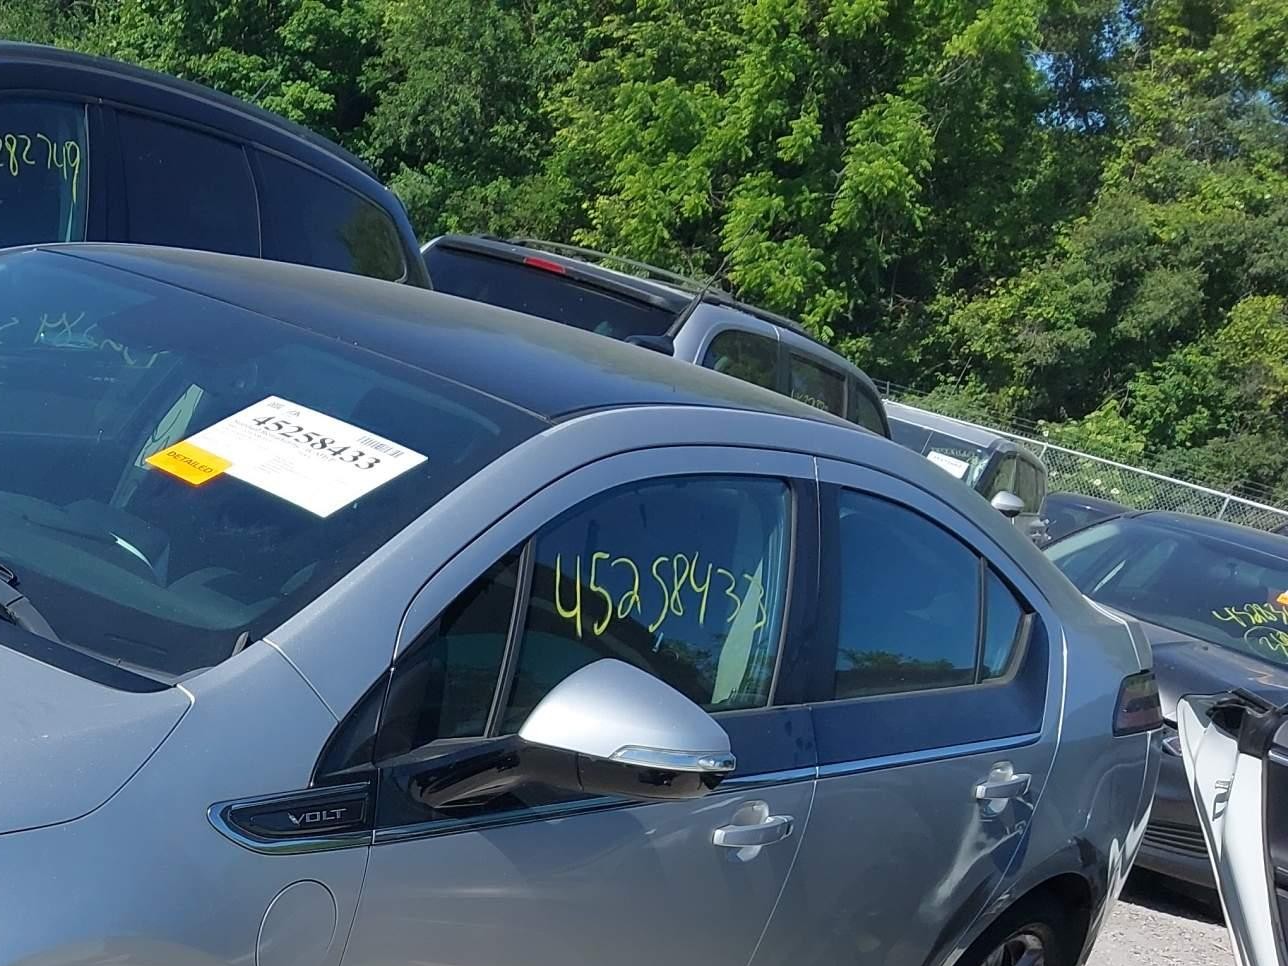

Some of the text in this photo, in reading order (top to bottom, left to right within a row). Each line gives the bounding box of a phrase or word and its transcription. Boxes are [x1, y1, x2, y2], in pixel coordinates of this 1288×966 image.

[252, 415, 381, 470] 45258433
[166, 450, 214, 474] DETAILED
[287, 807, 347, 825] VOLT
